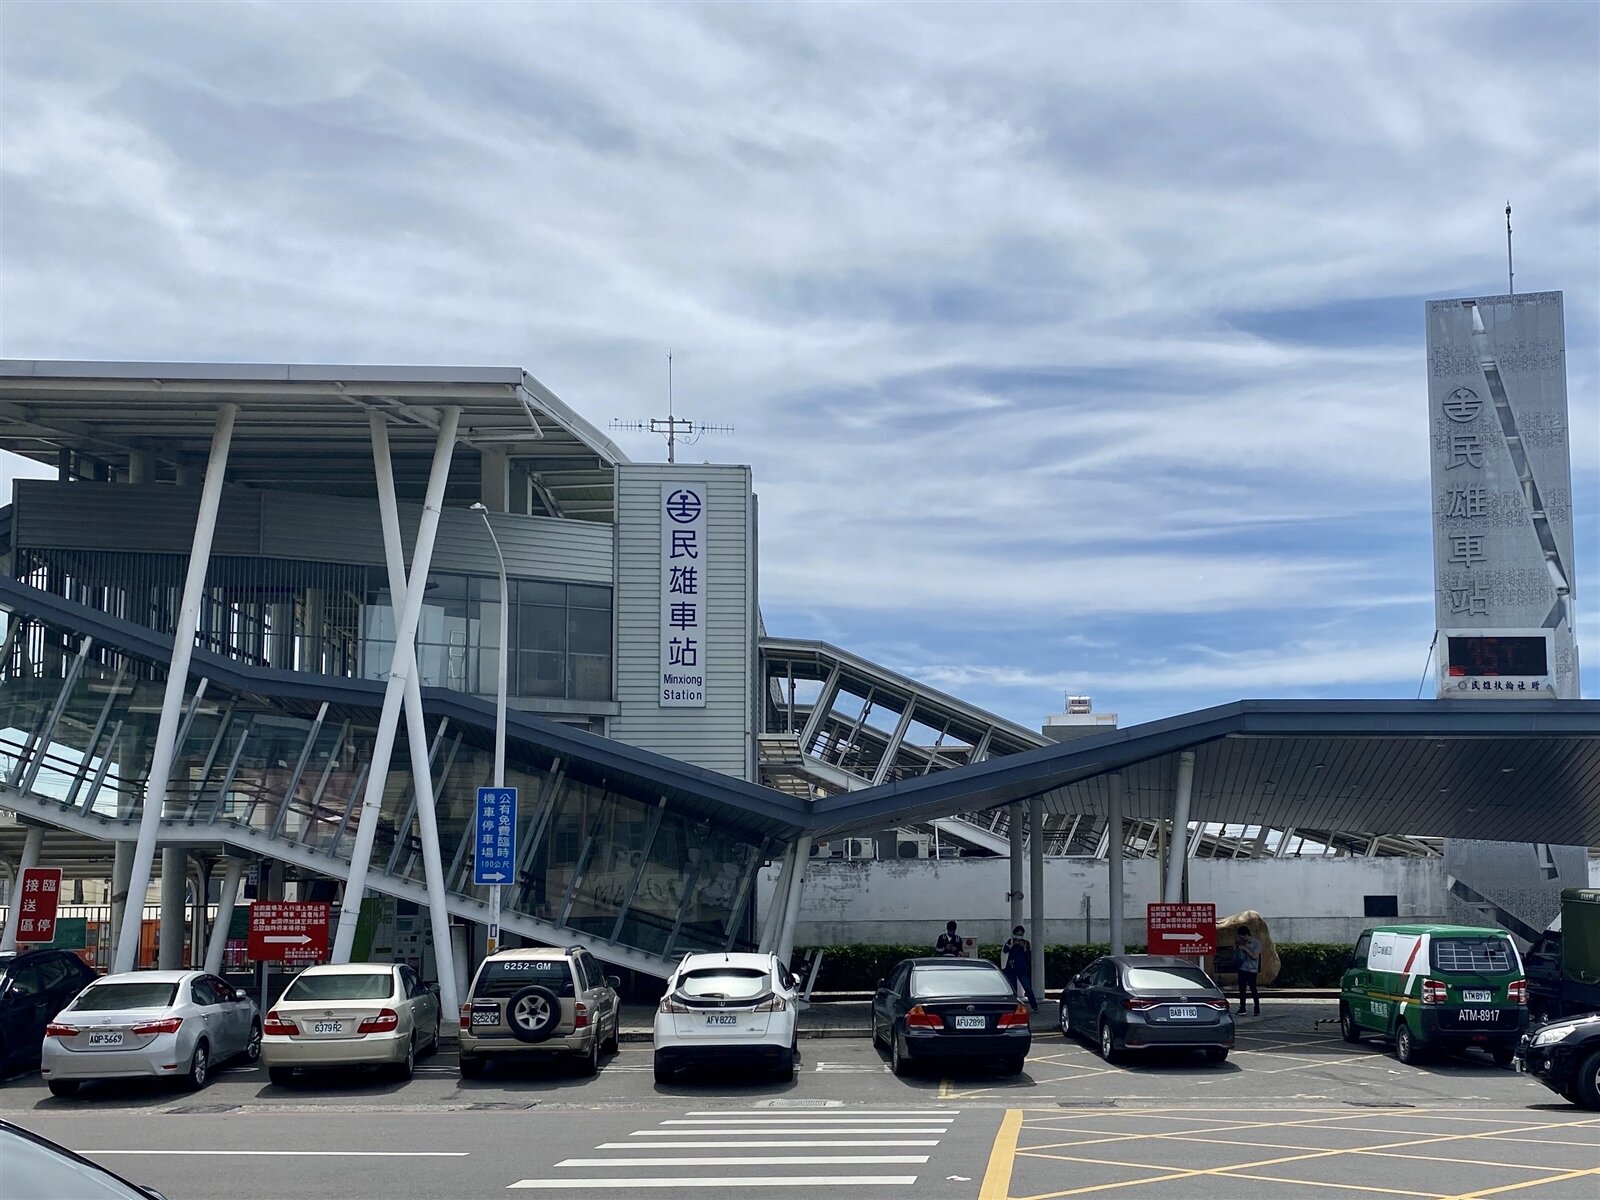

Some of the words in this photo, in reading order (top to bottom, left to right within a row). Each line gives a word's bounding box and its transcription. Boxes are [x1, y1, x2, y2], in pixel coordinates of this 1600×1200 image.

[1445, 433, 1490, 616] 民雄車站
[668, 529, 699, 667] 民雄車站
[663, 673, 702, 687] Minxiong
[663, 689, 702, 700] Station
[481, 793, 496, 858] 機車停車場
[497, 793, 511, 859] 公有免費臨時
[481, 860, 510, 869] 100公尺
[504, 962, 551, 970] 6252-GM
[1458, 1009, 1500, 1022] ATM-8917
